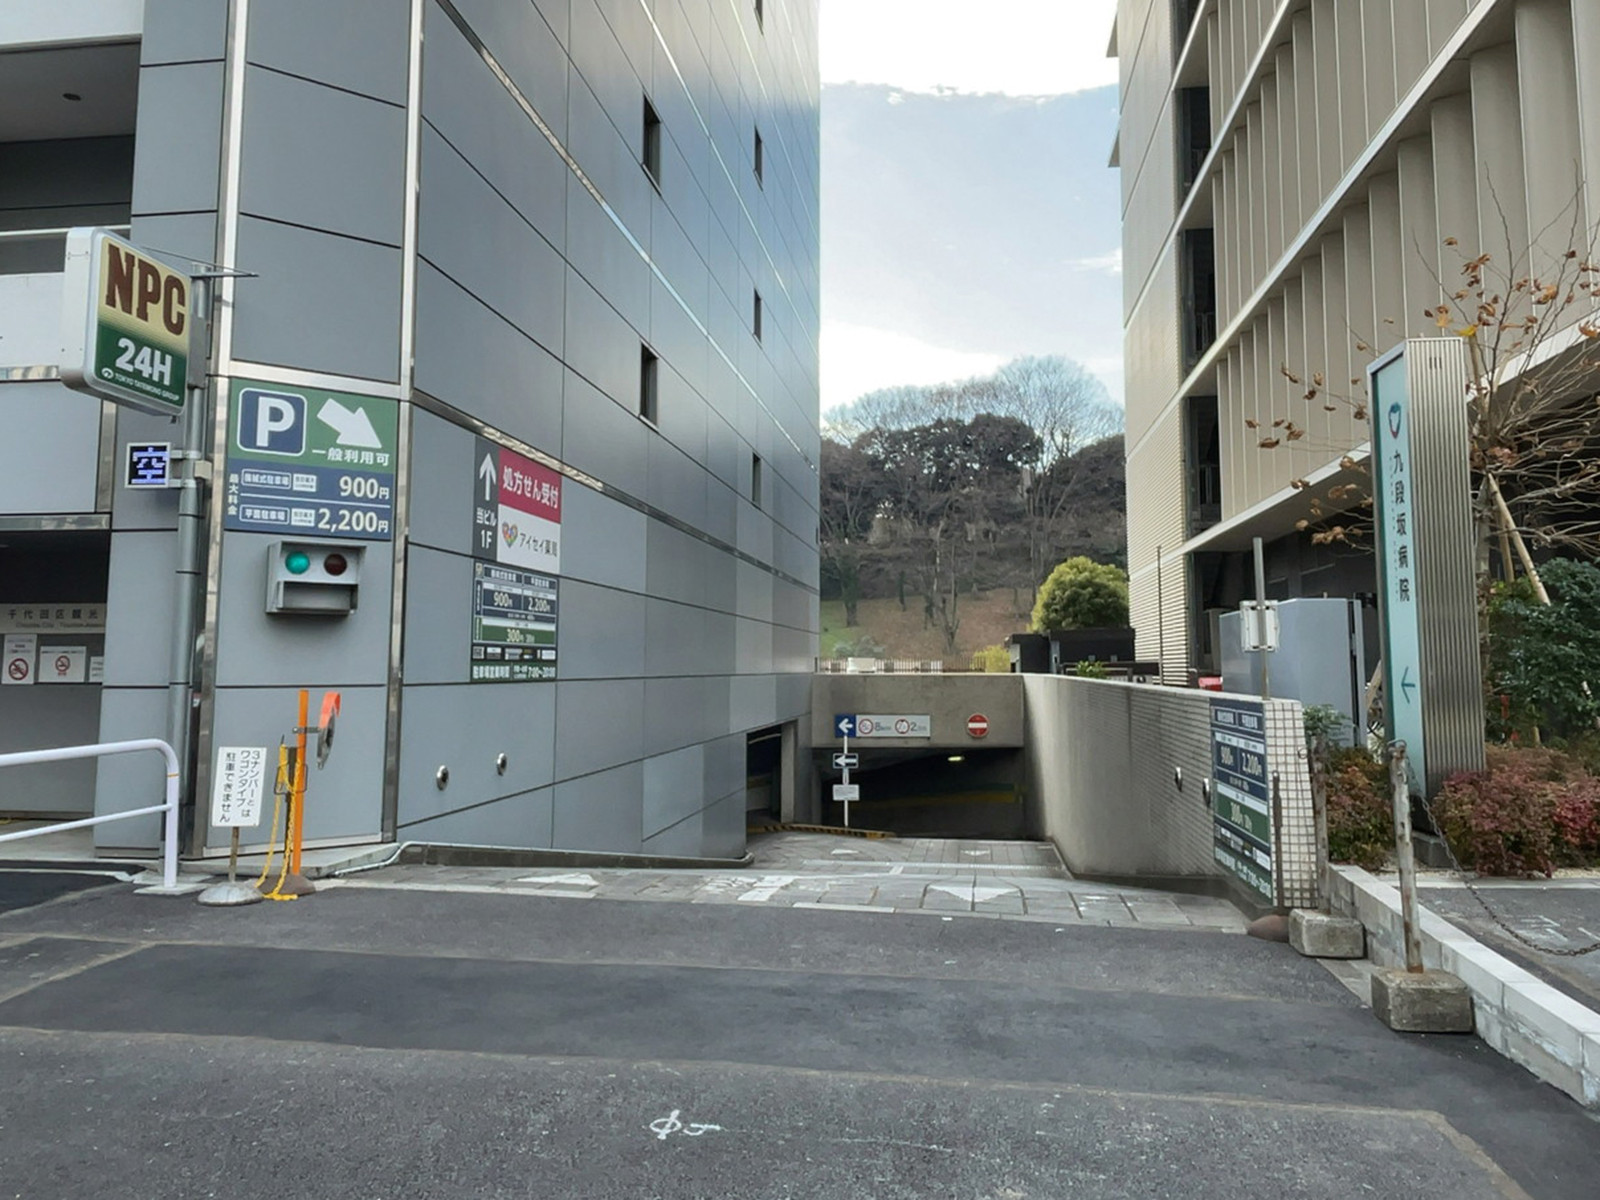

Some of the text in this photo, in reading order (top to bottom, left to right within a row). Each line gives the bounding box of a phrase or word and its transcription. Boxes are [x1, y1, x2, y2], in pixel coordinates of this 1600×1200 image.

[105, 243, 185, 336] NPC
[115, 337, 172, 386] 24H
[256, 396, 295, 447] P
[132, 447, 168, 484] 空
[312, 447, 390, 467] 一般利用可
[339, 475, 389, 500] 900円
[503, 465, 559, 509] 処方せん受付
[317, 508, 389, 533] 2,200円
[476, 507, 497, 526] 当ビル
[1393, 450, 1410, 602] 九段坂病院
[481, 529, 492, 549] 1F
[519, 532, 558, 557] アイセイ薬局
[8, 608, 98, 620] 千代田区観光
[220, 752, 236, 823] 駐車できません
